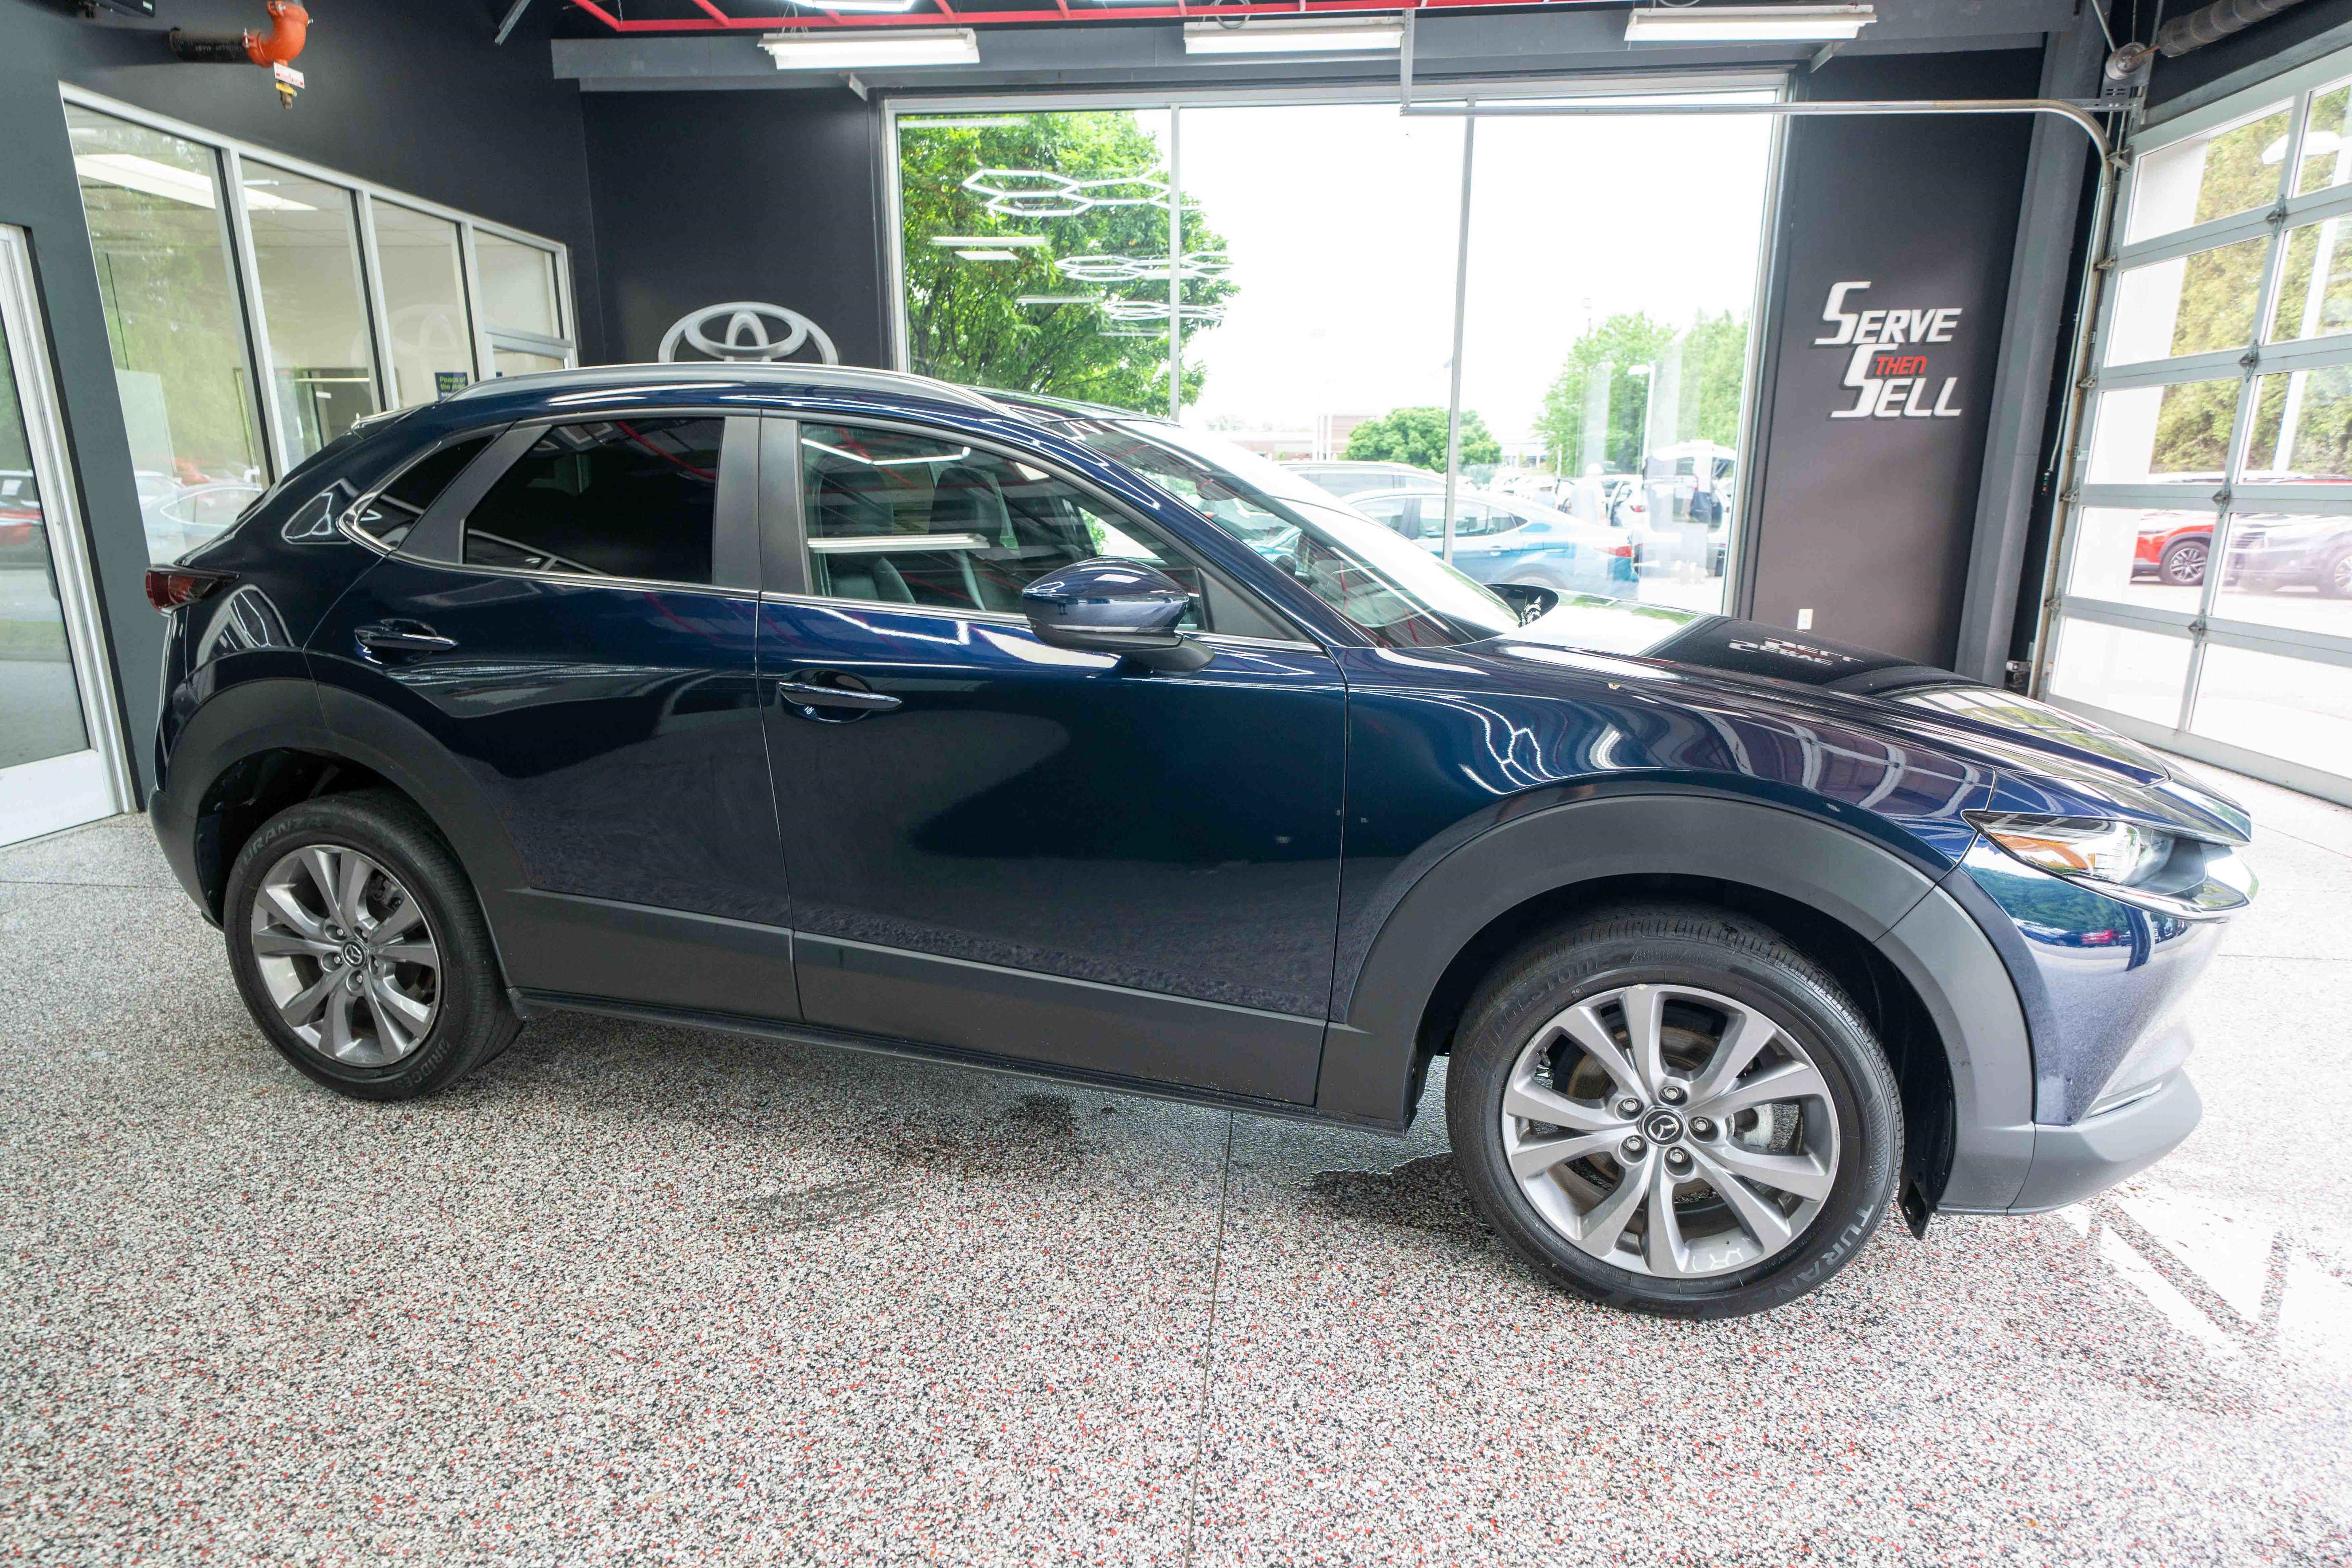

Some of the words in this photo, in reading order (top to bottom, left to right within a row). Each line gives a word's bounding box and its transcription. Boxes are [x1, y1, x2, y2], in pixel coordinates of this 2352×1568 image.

[1815, 281, 1962, 345] SERVE
[1831, 343, 1962, 418] SELL
[1875, 356, 1927, 375] THEN
[1750, 1205, 1874, 1303] TURAN
